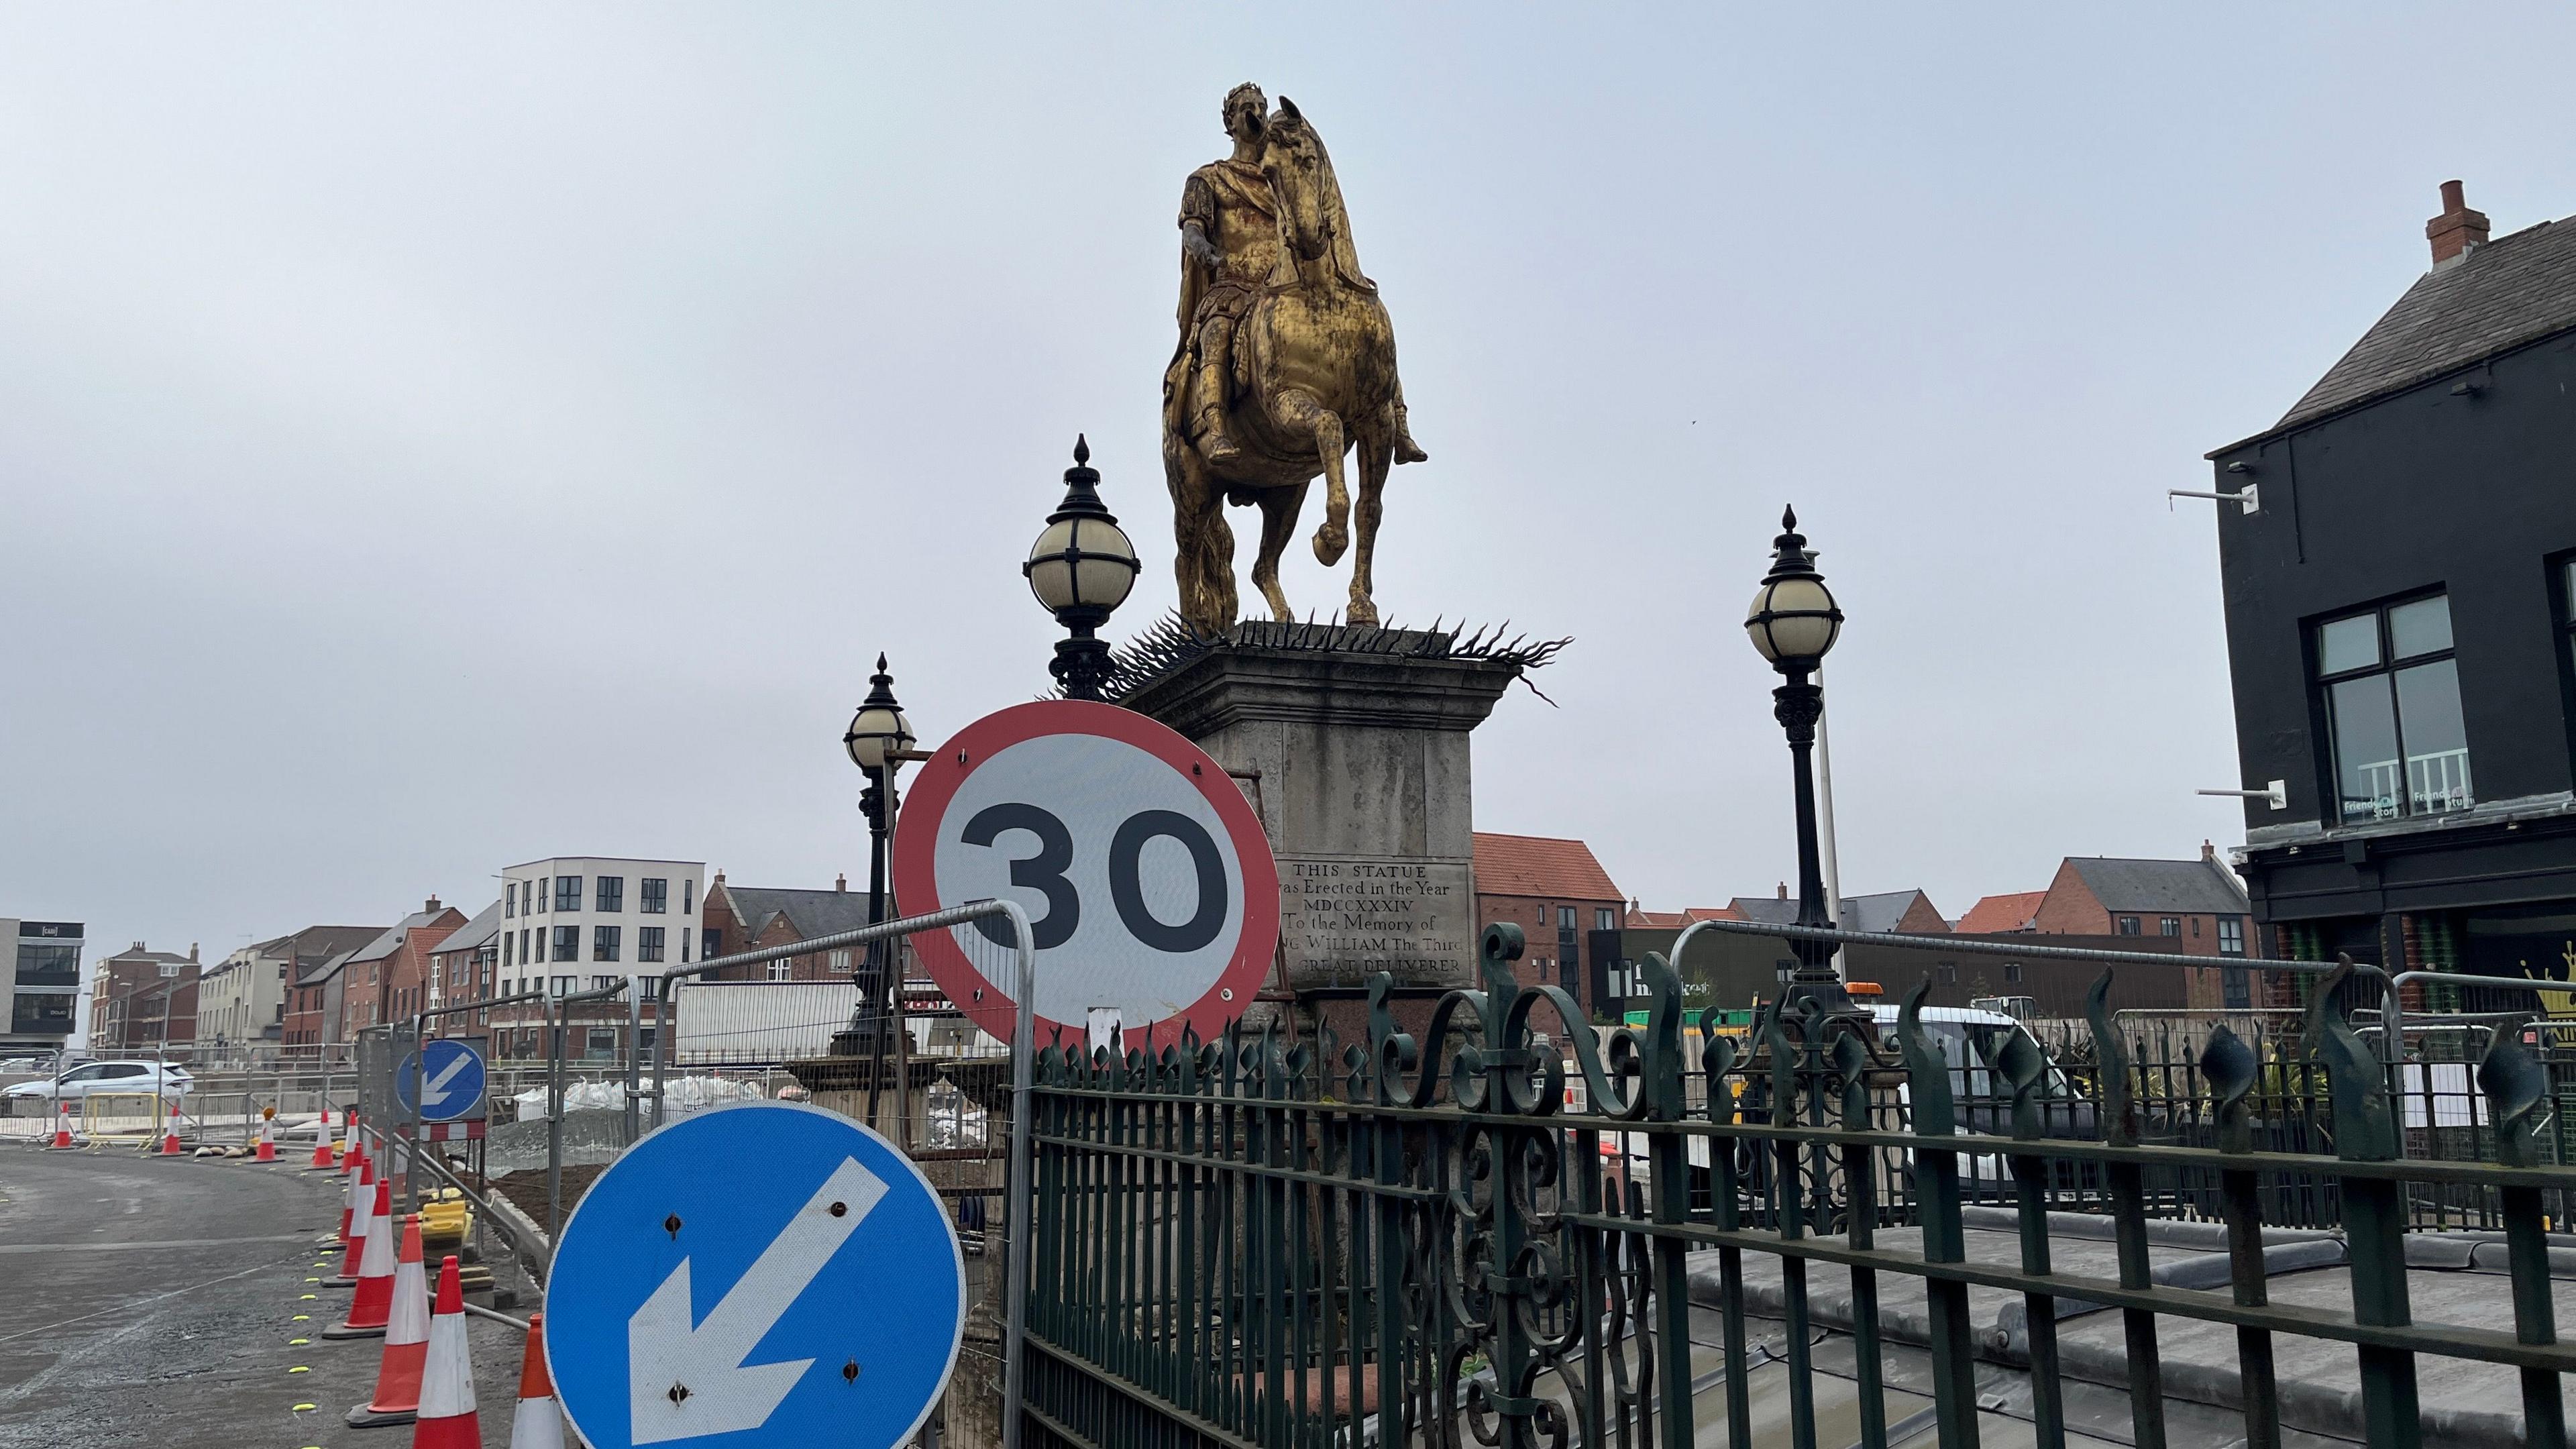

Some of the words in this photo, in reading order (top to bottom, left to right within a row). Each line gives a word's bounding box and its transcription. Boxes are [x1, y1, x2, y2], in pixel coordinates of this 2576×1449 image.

[961, 802, 1228, 953] 30
[1293, 863, 1340, 877] THIS
[1353, 865, 1426, 878] STATUE
[1279, 882, 1299, 894] as
[1303, 879, 1364, 895] Erected
[1371, 882, 1385, 896] in
[1390, 881, 1412, 896] the
[1415, 880, 1450, 896] Year
[1303, 899, 1414, 912] MDCCXXXIV
[1283, 912, 1305, 930] To
[1311, 914, 1337, 930] the
[1343, 913, 1413, 931] Memory
[1420, 914, 1436, 931] of
[1306, 934, 1386, 951] WILLIAM
[1393, 938, 1417, 951] The
[1424, 938, 1464, 952] Third
[1298, 959, 1356, 973] GREAT
[1364, 959, 1460, 973] DELIVERER
